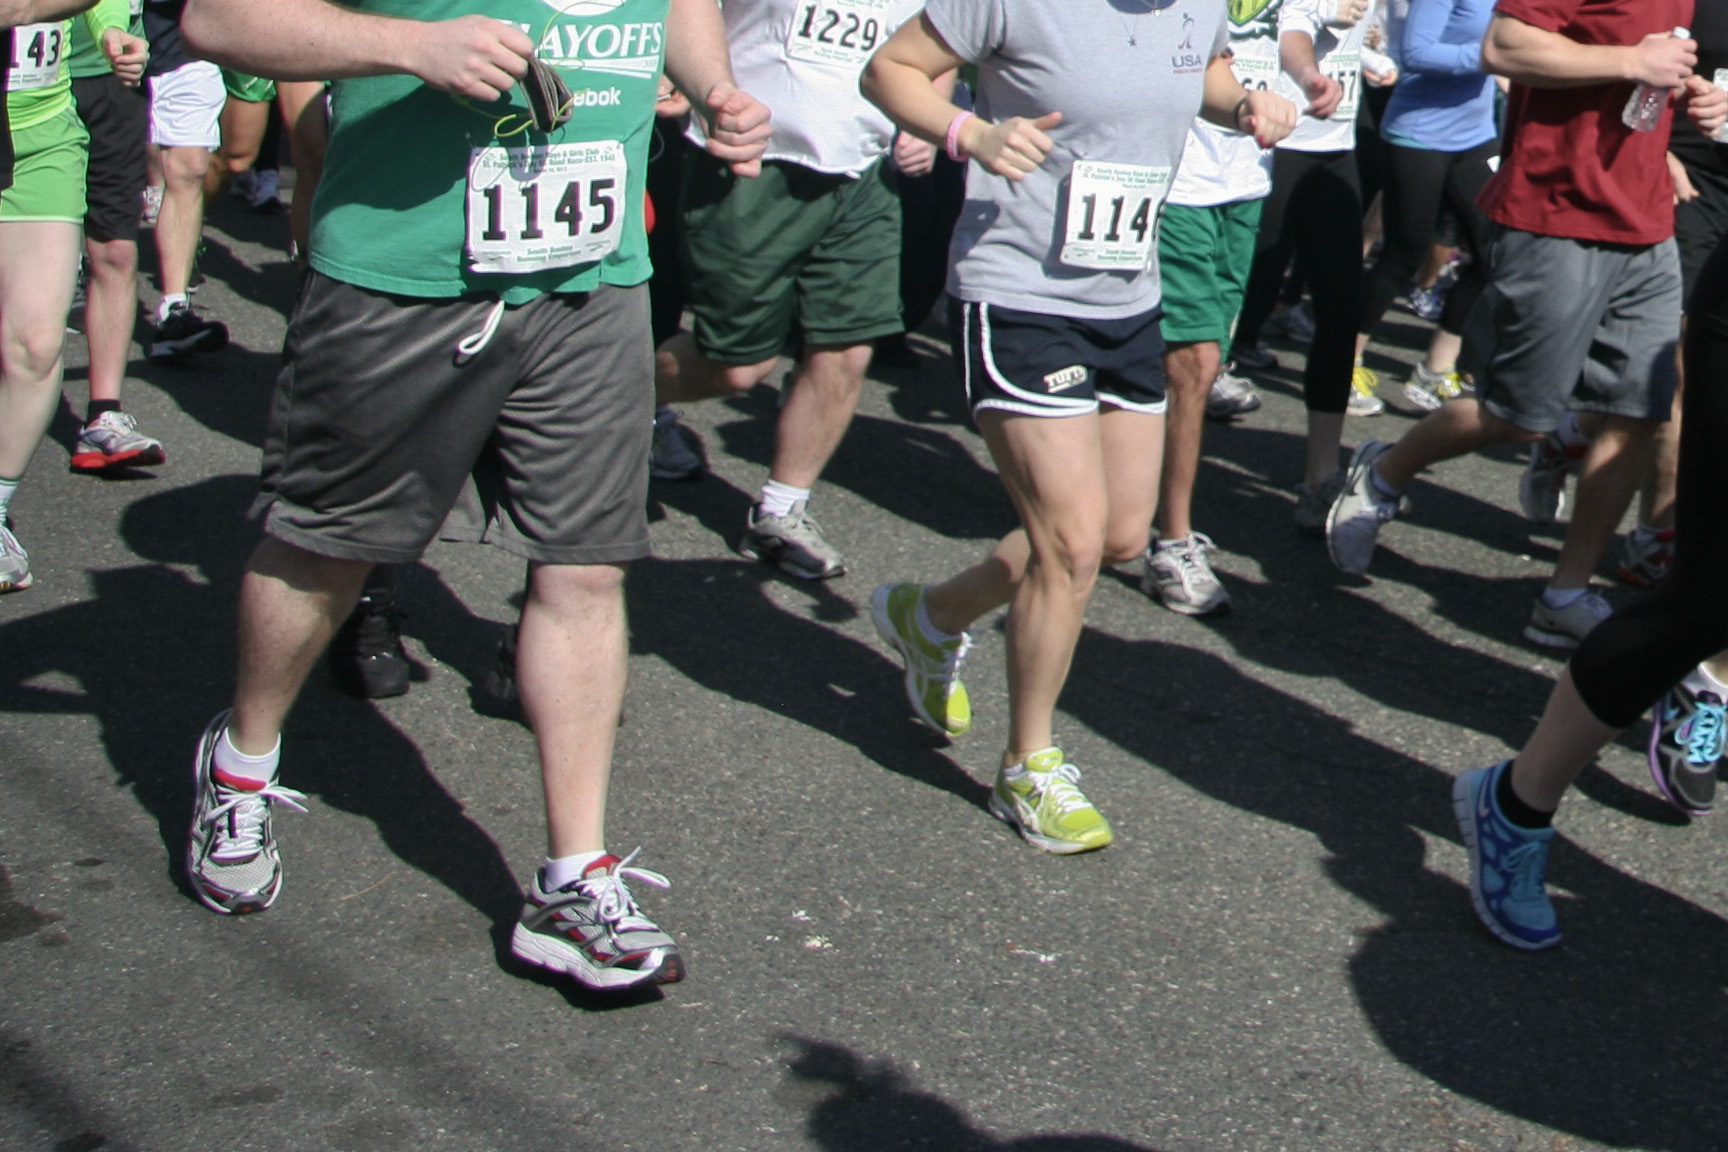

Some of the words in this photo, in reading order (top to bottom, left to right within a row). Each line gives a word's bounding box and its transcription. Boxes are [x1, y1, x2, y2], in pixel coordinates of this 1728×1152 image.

[500, 20, 663, 60] AYOFFS
[797, 4, 879, 52] 1229
[1172, 54, 1201, 68] USA
[573, 87, 621, 107] ebok
[482, 178, 615, 240] 1145
[1077, 192, 1158, 243] 114
